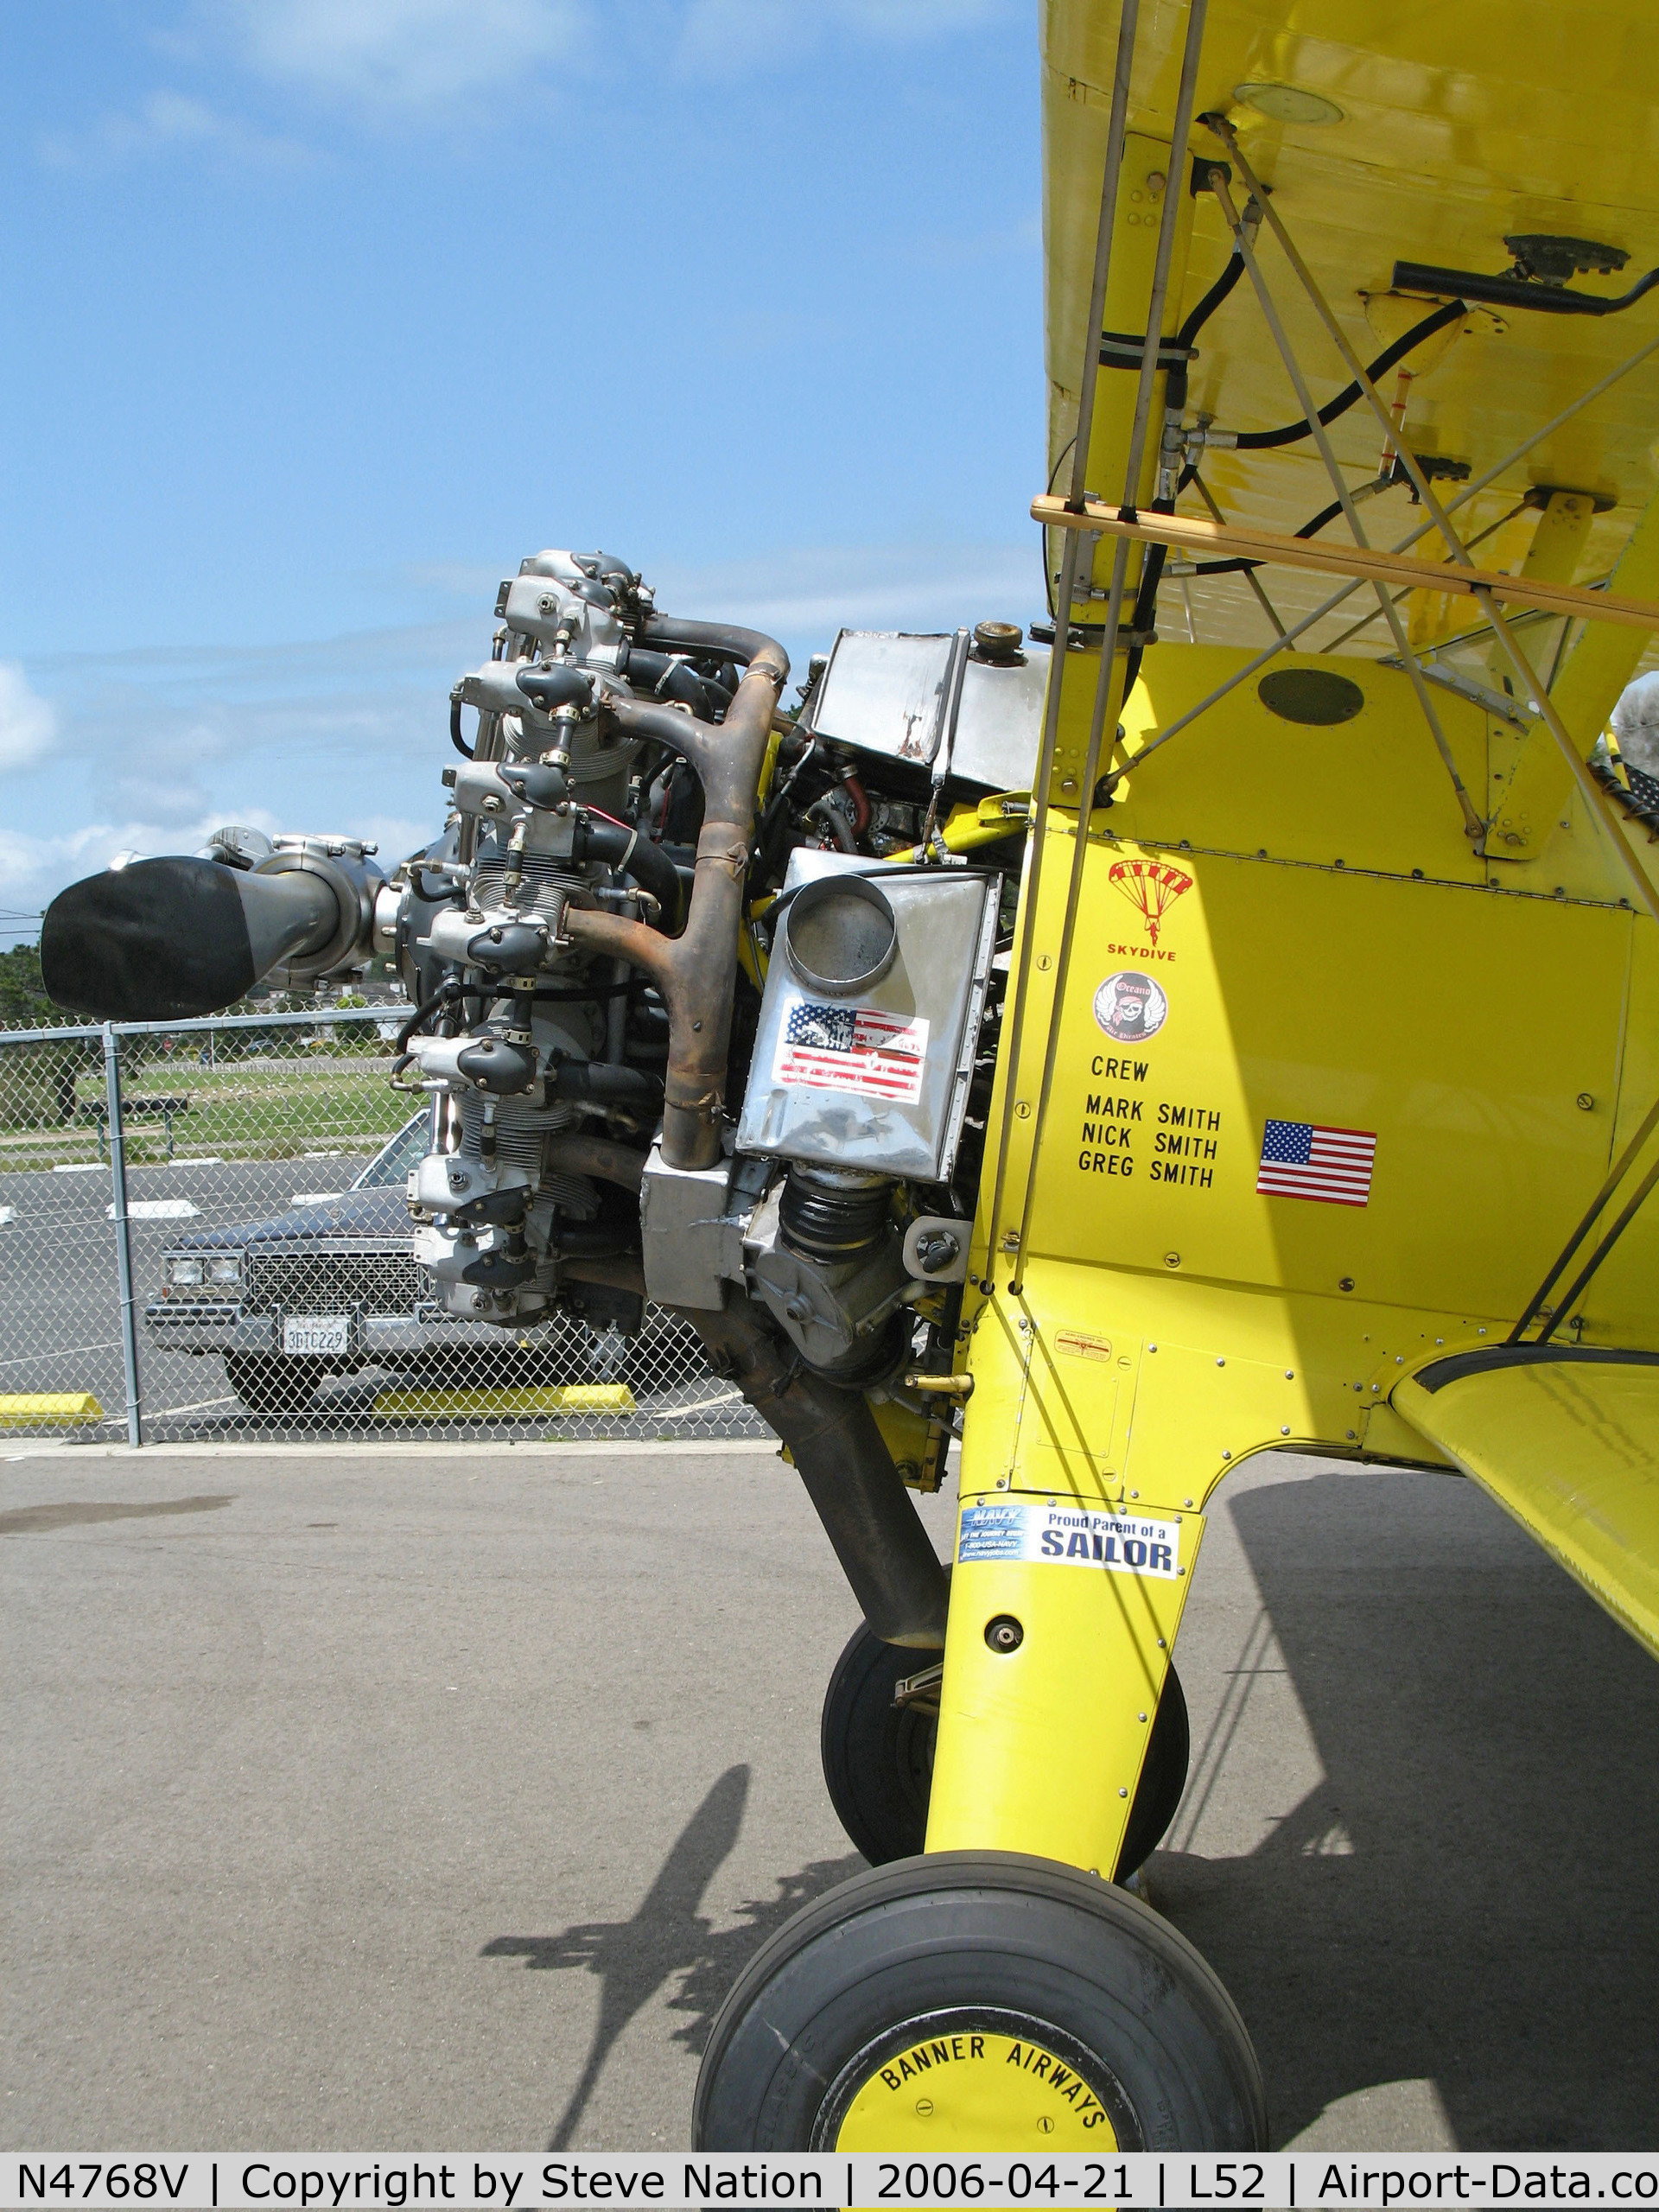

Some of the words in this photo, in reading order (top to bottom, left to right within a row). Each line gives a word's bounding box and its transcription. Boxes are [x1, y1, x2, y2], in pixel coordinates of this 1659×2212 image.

[1108, 944, 1176, 962] SKYDIVE
[1116, 982, 1151, 995] Oceano
[1091, 1055, 1149, 1082] CREW
[1085, 1094, 1144, 1122] MARK
[1157, 1103, 1221, 1132] SMITH
[1082, 1122, 1132, 1148] NICK
[1154, 1132, 1217, 1160] SMITH
[1078, 1150, 1134, 1177] GREG
[1149, 1160, 1214, 1189] SMITH
[971, 1508, 1021, 1527] NAVY
[1048, 1513, 1089, 1529] Proud
[1093, 1517, 1136, 1534] Parent
[1141, 1526, 1154, 1537] of
[1158, 1529, 1166, 1539] a
[1041, 1529, 1172, 1572] SAILOR
[880, 2036, 985, 2092] BANNER
[1006, 2043, 1105, 2129] AIRWAYS
